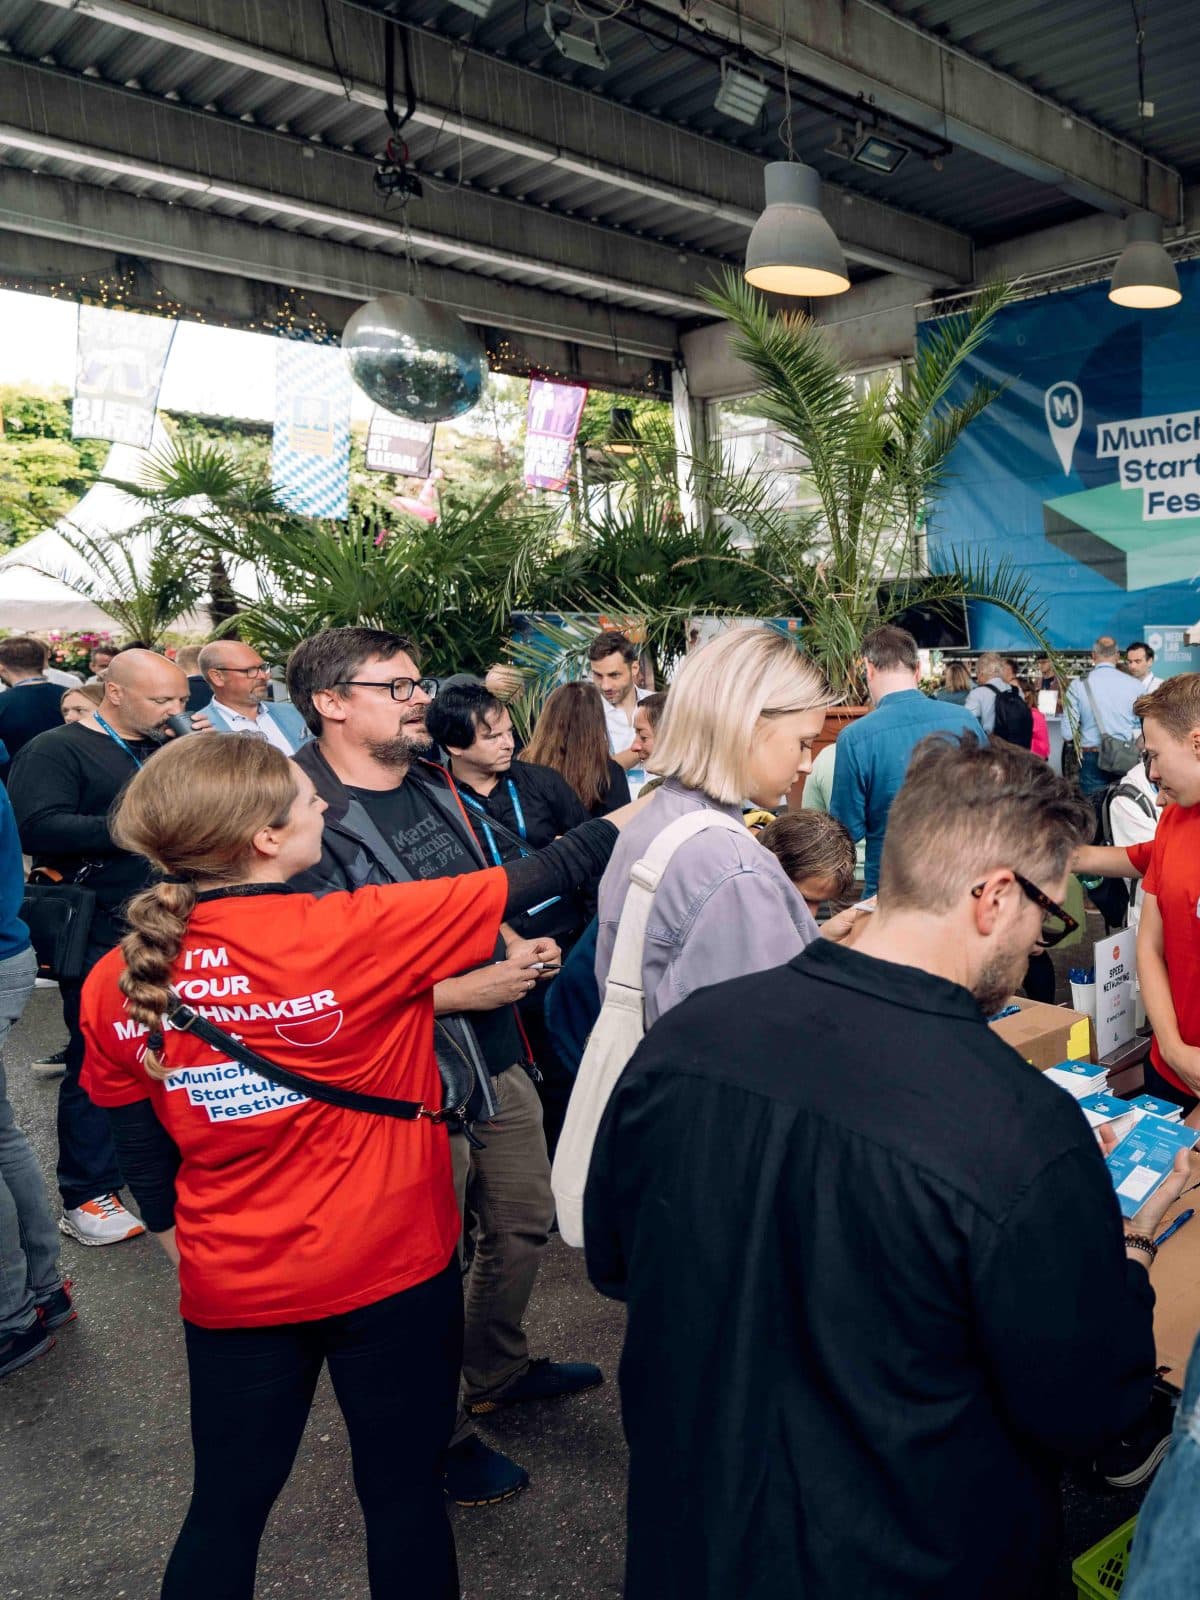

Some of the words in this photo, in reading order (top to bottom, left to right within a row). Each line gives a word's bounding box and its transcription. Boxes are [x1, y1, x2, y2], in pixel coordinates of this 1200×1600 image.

[1052, 394, 1074, 421] M
[1109, 963, 1124, 978] SPEED
[168, 975, 252, 999] YOUR
[112, 989, 340, 1041] MAHMAKER
[209, 1092, 307, 1119] Festiva
